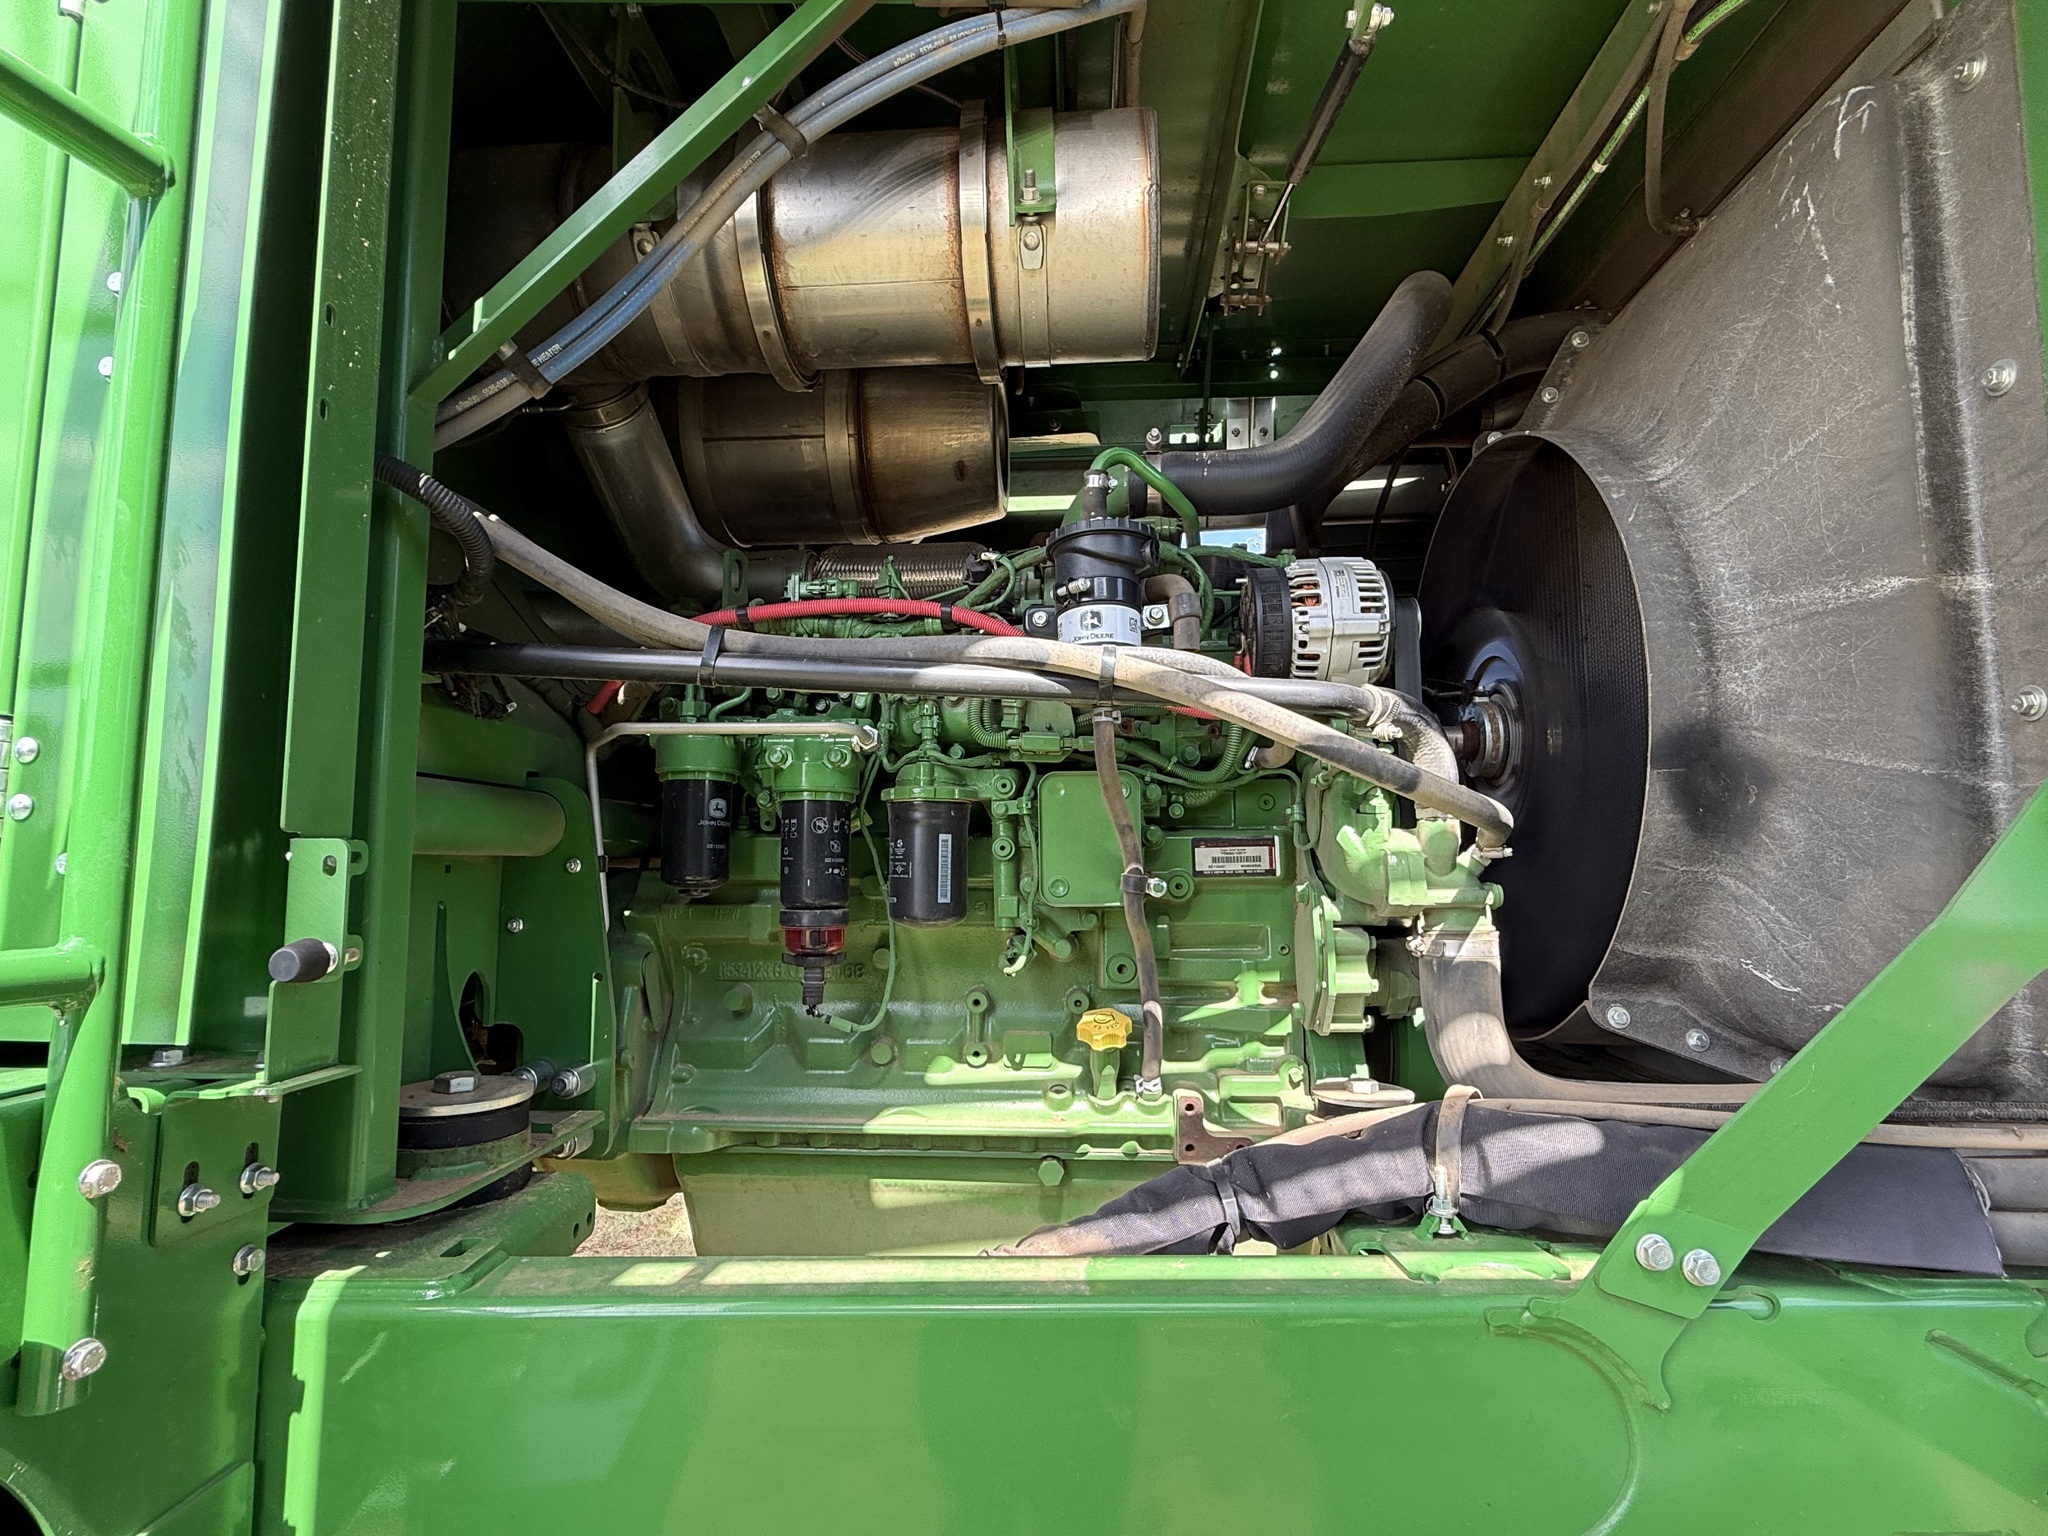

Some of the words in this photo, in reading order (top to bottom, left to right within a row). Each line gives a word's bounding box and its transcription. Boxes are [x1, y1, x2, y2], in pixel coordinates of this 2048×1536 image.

[537, 342, 564, 366] HEATER
[1071, 634, 1090, 643] JOHN
[1090, 632, 1115, 640] DEERE
[697, 819, 717, 827] JOHN
